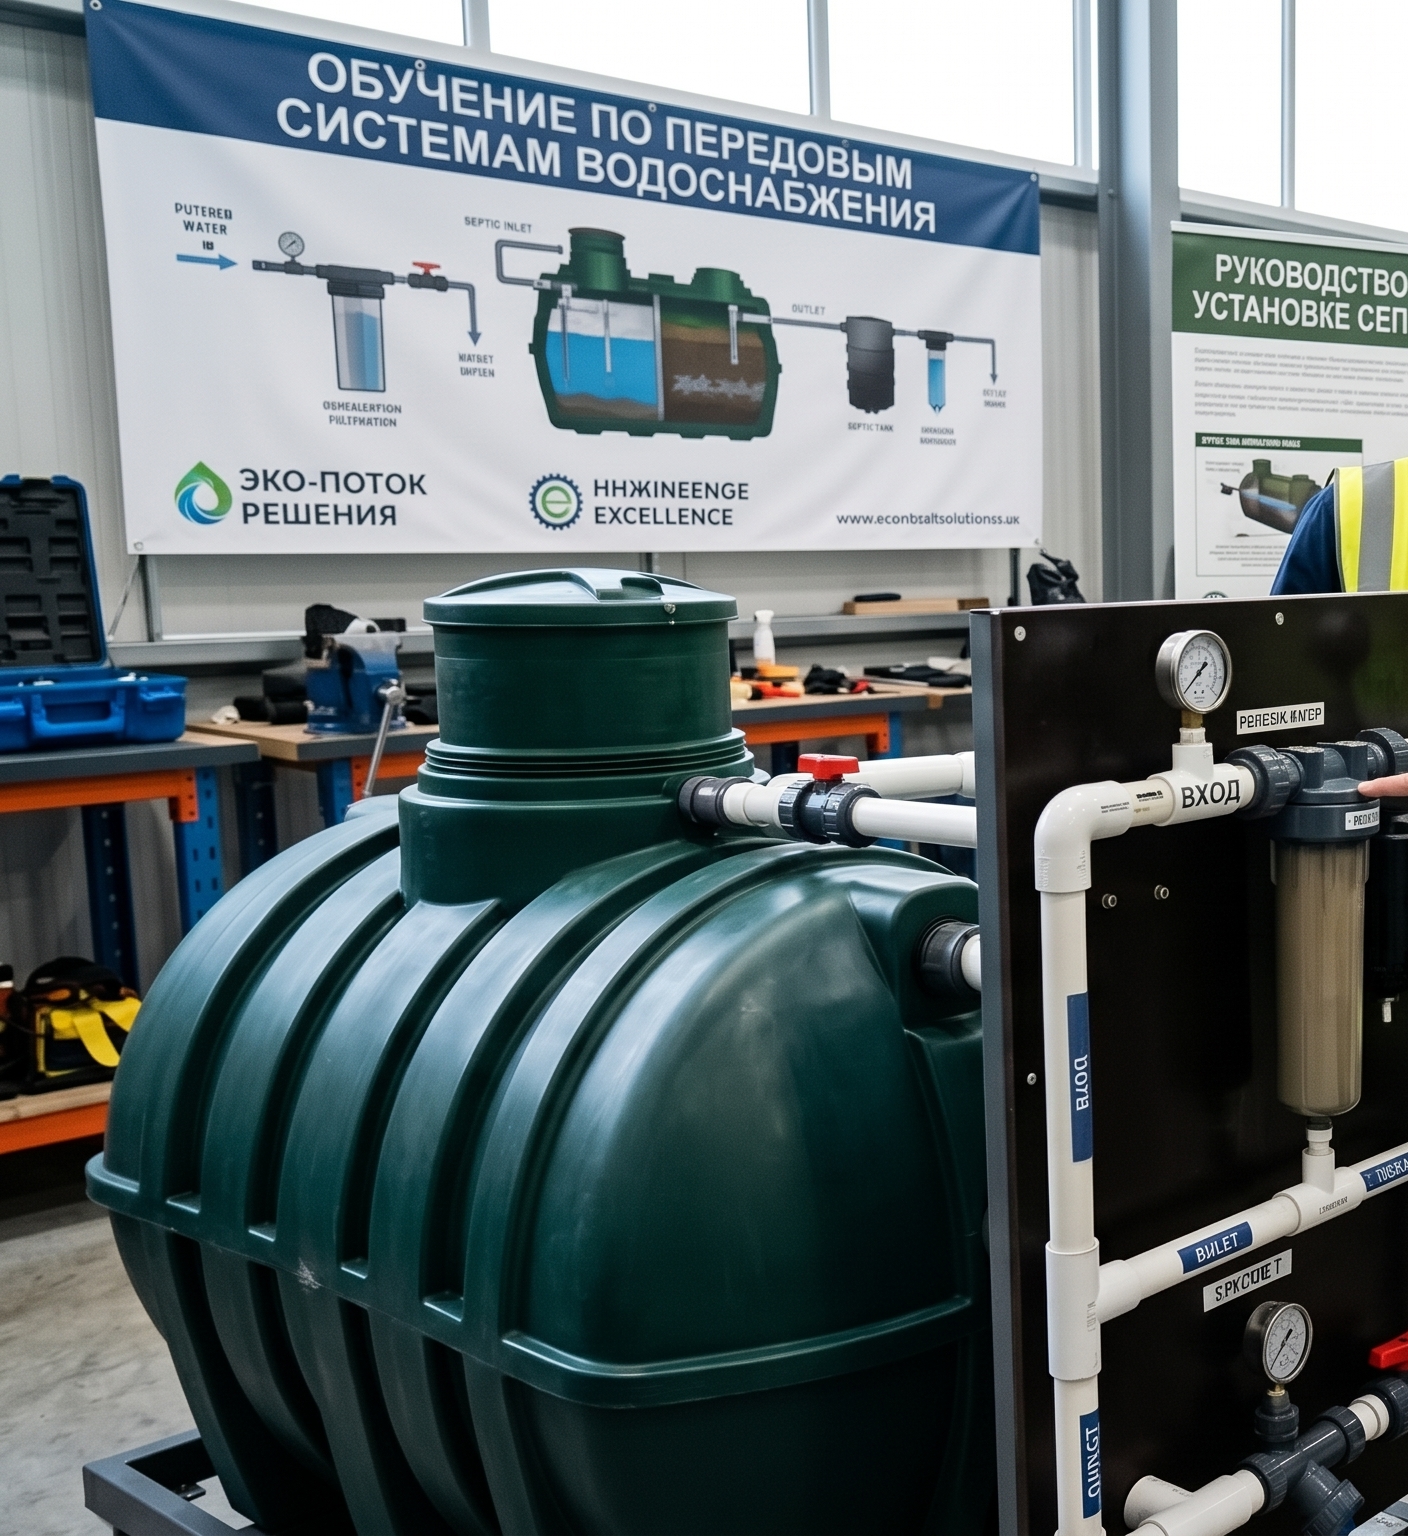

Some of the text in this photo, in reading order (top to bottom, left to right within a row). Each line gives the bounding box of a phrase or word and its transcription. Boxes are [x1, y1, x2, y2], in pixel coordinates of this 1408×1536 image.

[308, 52, 912, 190] ОБУЧЕНИЕ ПО ПЕРЕДОВЫМ
[277, 97, 936, 234] СИСТЕМАМ ВОДОСНАБЖЕНИЯ
[183, 220, 227, 235] WATER
[464, 216, 532, 233] SEPTIC INLET
[1216, 254, 1408, 298] РУКОВОДСТВО
[1192, 291, 1350, 330] УСТАНОВКЕ
[240, 468, 427, 495] ЭКО-ПОТОК
[242, 502, 397, 526] РЕШЕНИЯ
[594, 506, 733, 526] EXCELLENCE
[1181, 779, 1241, 809] ВХОД
